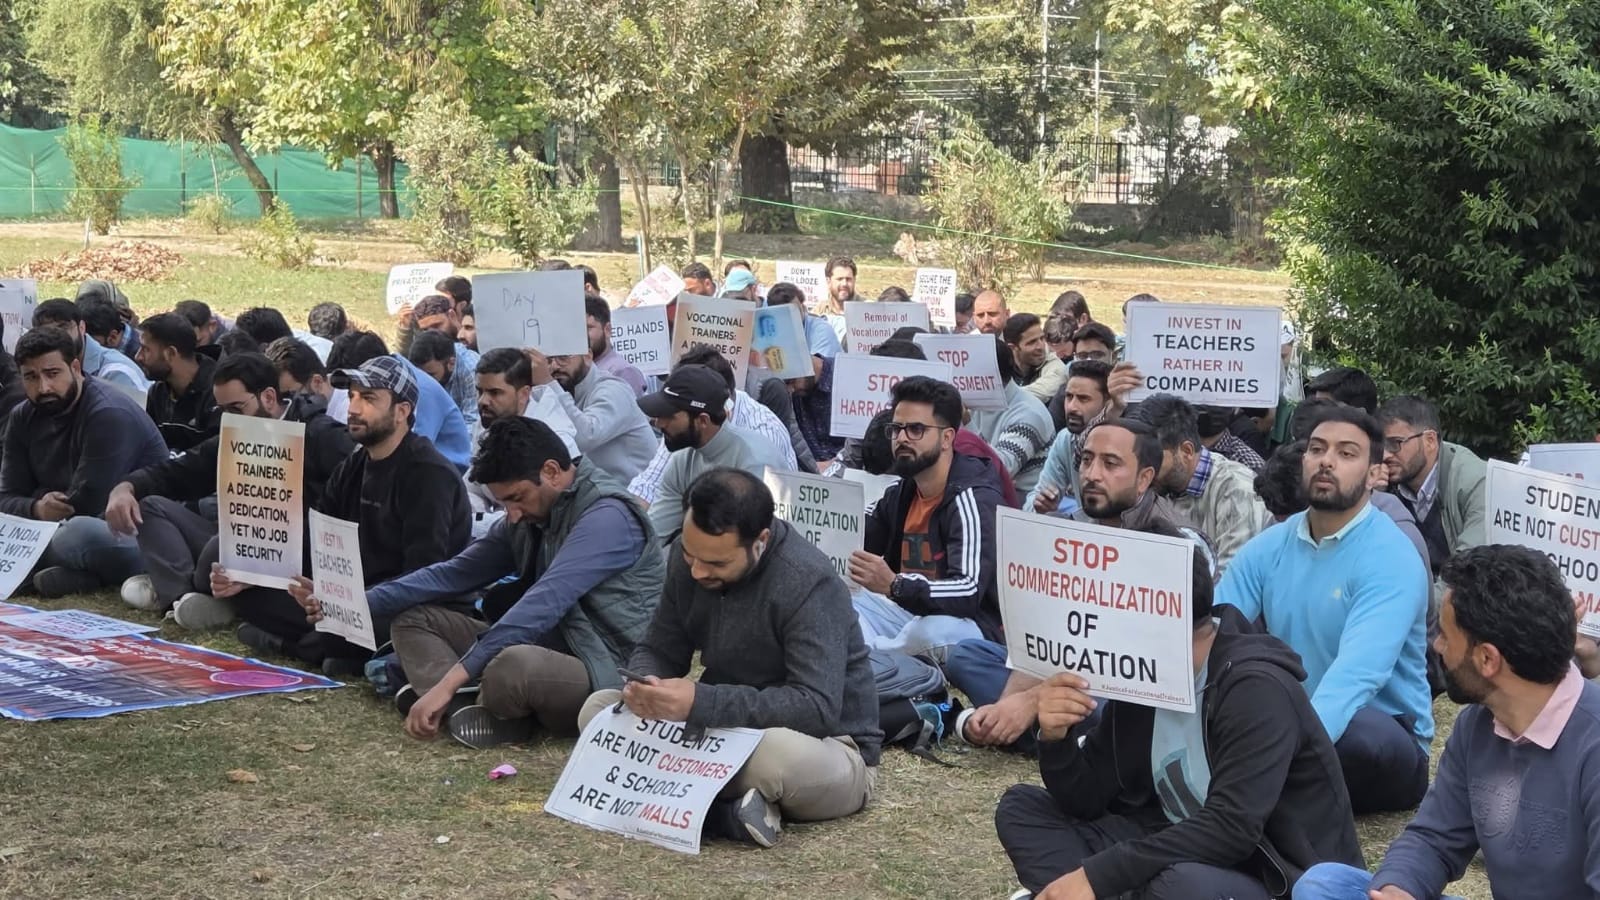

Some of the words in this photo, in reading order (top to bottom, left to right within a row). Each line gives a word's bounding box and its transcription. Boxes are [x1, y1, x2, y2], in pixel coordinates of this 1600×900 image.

[939, 275, 952, 285] THE
[502, 287, 536, 315] DAY
[686, 312, 744, 327] VOCATIONAL
[864, 312, 898, 322] Removal
[900, 312, 908, 322] of
[1168, 317, 1222, 330] INVEST
[1227, 319, 1241, 330] IN
[522, 318, 541, 346] 19
[611, 326, 624, 338] ED
[627, 320, 665, 336] HANDS
[691, 327, 737, 341] TRAINERS:
[851, 328, 891, 337] Vocational
[681, 341, 689, 349] A
[729, 346, 742, 356] OF
[1153, 334, 1255, 351] TEACHERS
[624, 350, 658, 364] IGHTS!
[937, 350, 969, 368] STOP
[1163, 358, 1222, 372] RATHER
[1228, 360, 1243, 372] IN
[867, 374, 908, 393] STO
[953, 376, 995, 391] SSMENT
[1146, 376, 1259, 394] COMPANIES
[231, 440, 293, 461] VOCATIONAL
[236, 462, 286, 481] TRAINERS:
[227, 482, 235, 495] A
[237, 483, 276, 500] DECADE
[279, 489, 293, 502] OF
[799, 485, 829, 504] STOP
[230, 502, 290, 525] DEDICATION,
[773, 503, 859, 533] PRIVATIZATION
[8, 526, 41, 542] INDIA
[231, 522, 250, 536] YET
[252, 525, 266, 540] NO
[269, 529, 288, 543] JOB
[1493, 508, 1521, 532] ARE
[1526, 515, 1556, 541] NOT
[806, 530, 821, 546] OF
[3, 543, 36, 558] WITH
[235, 543, 283, 562] SECURITY
[1053, 538, 1119, 571] STOP
[315, 550, 353, 577] TEACHERS
[1008, 562, 1182, 619] COMMERCIALIZATION
[320, 600, 363, 630] COMPANIES
[1067, 610, 1098, 638] OF
[1025, 633, 1157, 683] EDUCATION
[590, 728, 626, 753] ARE
[625, 740, 660, 766] NOT
[657, 753, 733, 780] CUSTOMERS
[605, 765, 620, 785] &
[622, 772, 692, 798] SCHOOLS
[570, 784, 611, 810] ARE
[609, 797, 642, 818] NOT
[638, 802, 693, 829] MALLS
